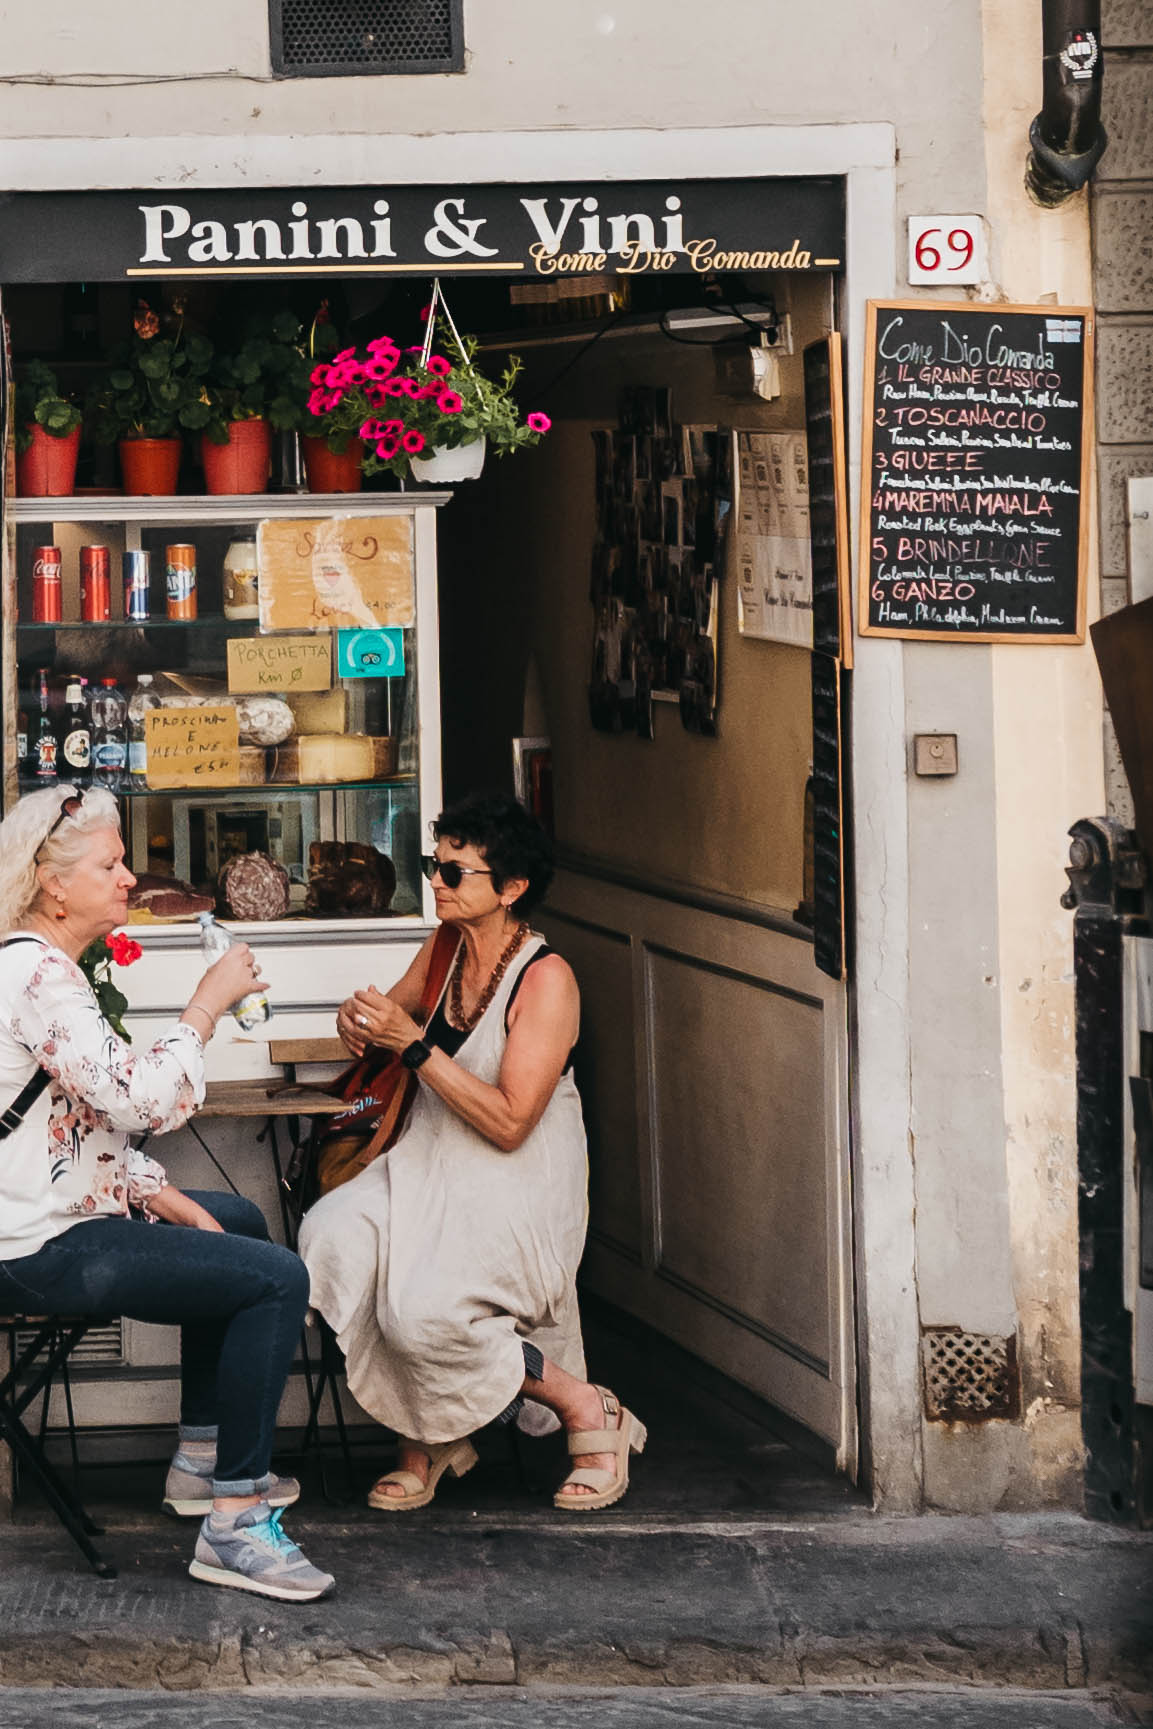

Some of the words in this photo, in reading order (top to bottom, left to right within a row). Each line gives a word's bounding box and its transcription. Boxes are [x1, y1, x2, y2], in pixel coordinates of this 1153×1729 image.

[138, 199, 397, 263] Panini
[424, 198, 499, 258] &
[519, 196, 687, 255] Vini
[528, 240, 608, 274] Come
[616, 239, 677, 274] Dio
[685, 238, 811, 272] Comanda
[914, 228, 975, 271] 69
[878, 316, 935, 366] Come
[940, 320, 983, 367] Dio
[985, 324, 1054, 370] Comanda
[897, 364, 915, 383] IL
[919, 365, 987, 385] GRANDE
[987, 368, 1062, 389] CLASSICO
[875, 407, 889, 427] 2
[893, 404, 1047, 432] TOSCANACCIO
[875, 451, 889, 469] 3
[891, 450, 986, 471] GIUEEE
[872, 489, 883, 511] 4
[884, 490, 973, 515] MAREMMA
[975, 493, 1054, 518] MAIALA
[872, 536, 888, 561] 5
[898, 536, 1052, 569] BRINDELLONE
[872, 581, 885, 602] 6
[892, 580, 976, 602] GANZO
[234, 643, 329, 668] PORCHETTA
[188, 730, 198, 742] E
